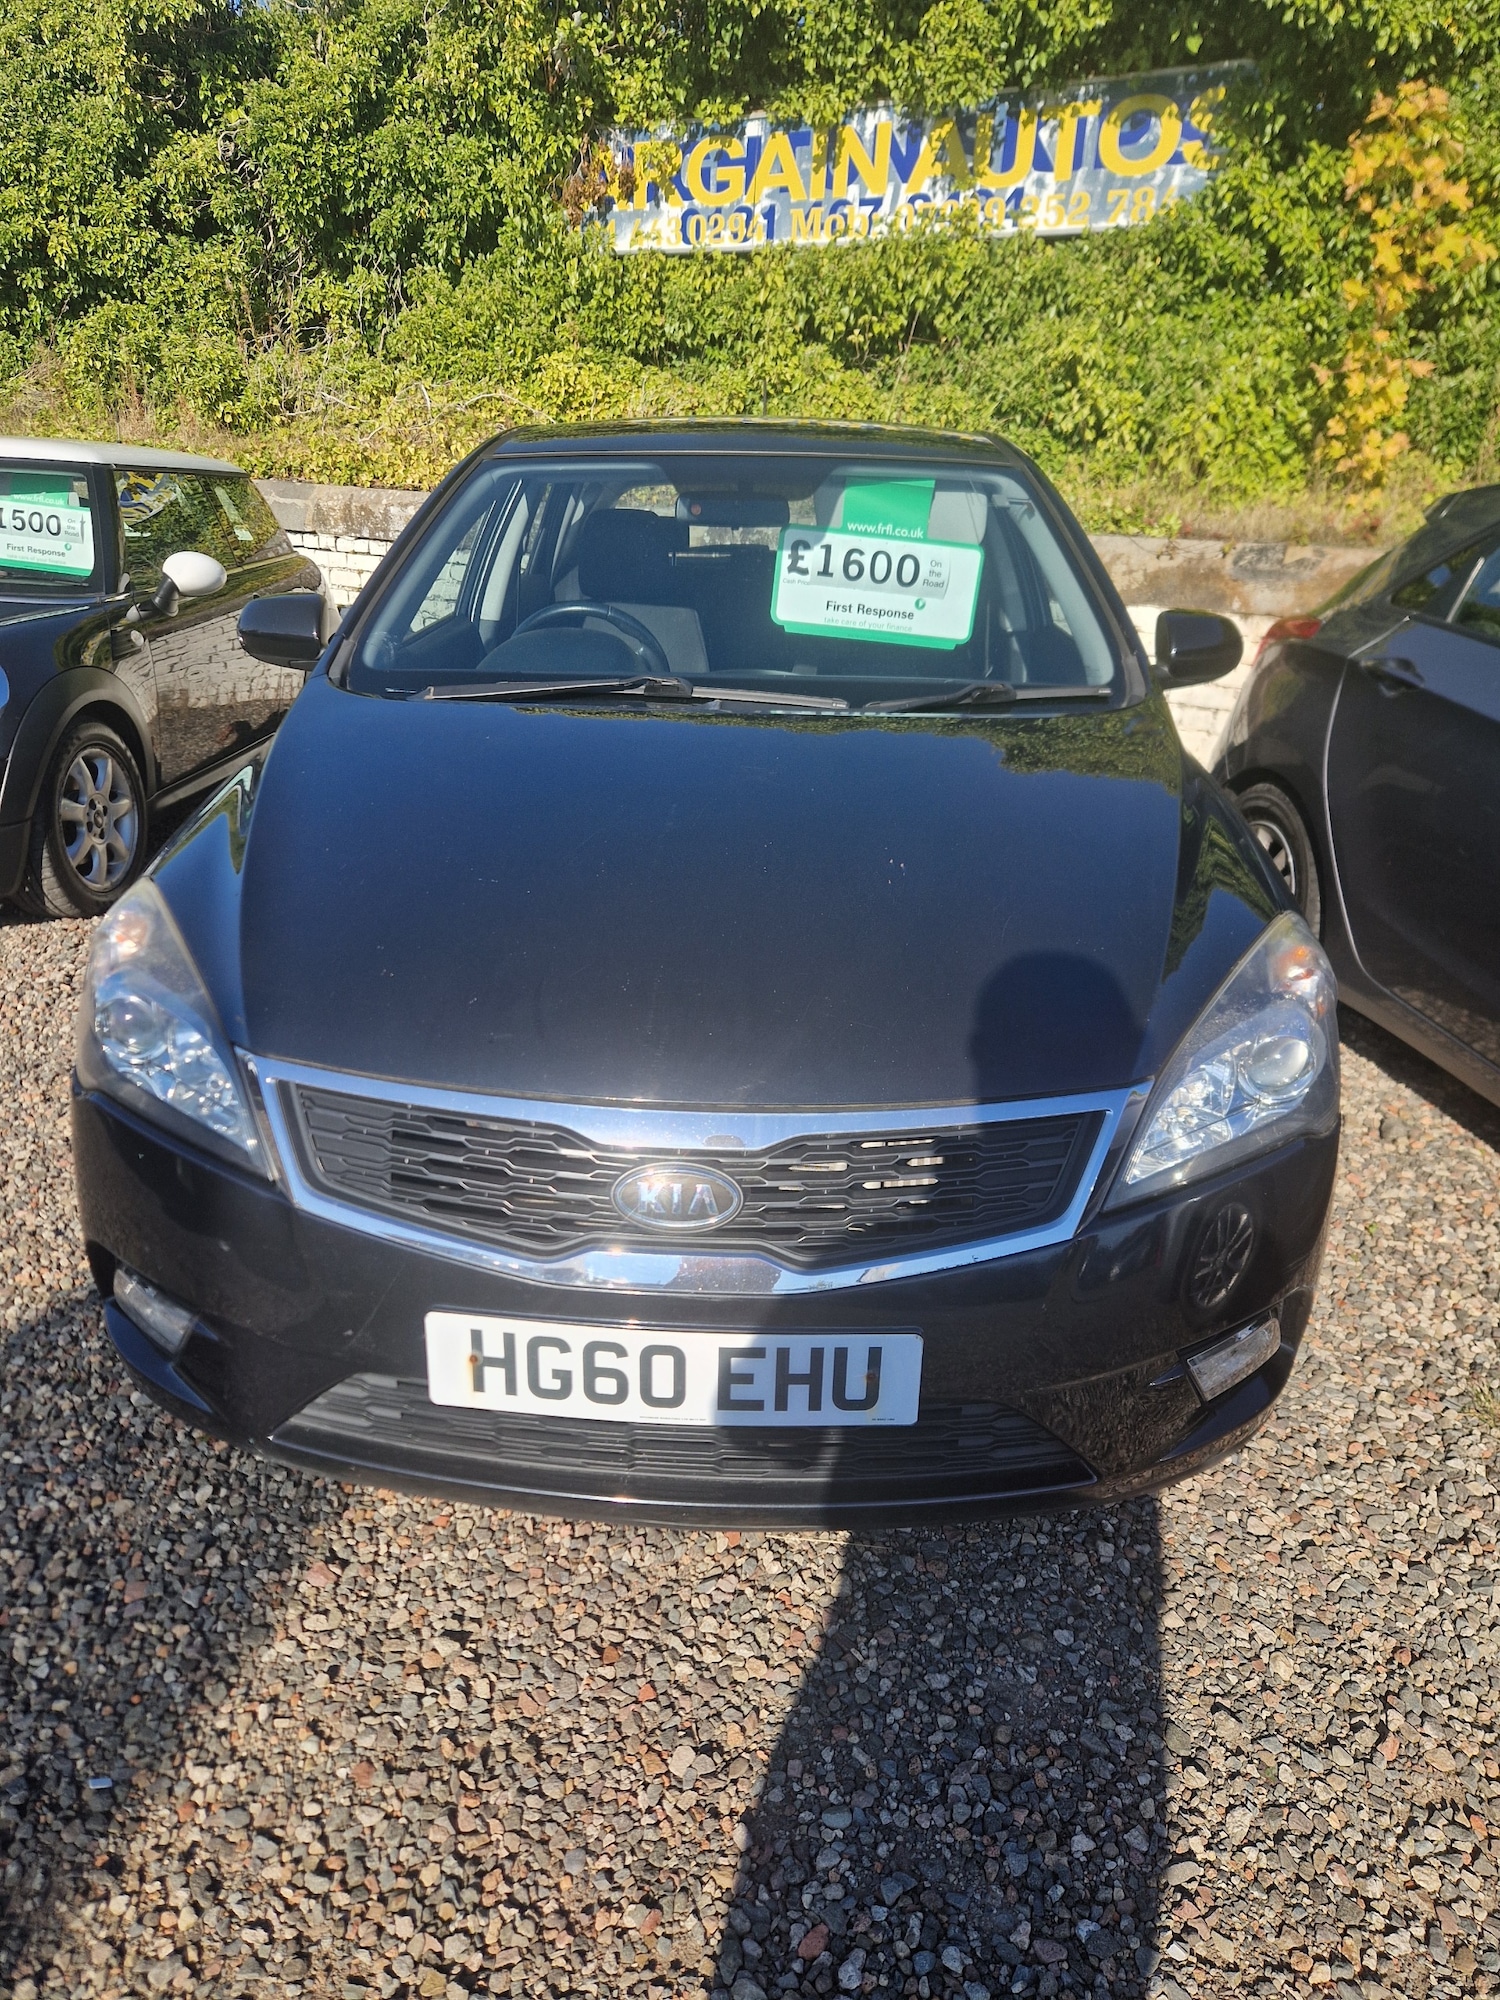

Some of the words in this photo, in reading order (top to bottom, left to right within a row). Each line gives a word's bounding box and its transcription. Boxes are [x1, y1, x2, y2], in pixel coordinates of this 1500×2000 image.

[847, 522, 924, 539] www.frfl.co.uk
[7, 543, 25, 552] First
[27, 545, 66, 558] Response
[786, 539, 921, 589] £1600
[930, 559, 943, 568] On
[928, 569, 942, 578] the
[922, 578, 945, 589] Road
[826, 600, 853, 614] First
[857, 604, 915, 620] Response
[859, 619, 867, 627] of
[868, 622, 884, 631] your
[886, 622, 913, 632] finance
[636, 1181, 720, 1216] KIA
[469, 1328, 687, 1410] HG60
[716, 1345, 883, 1413] EHU
